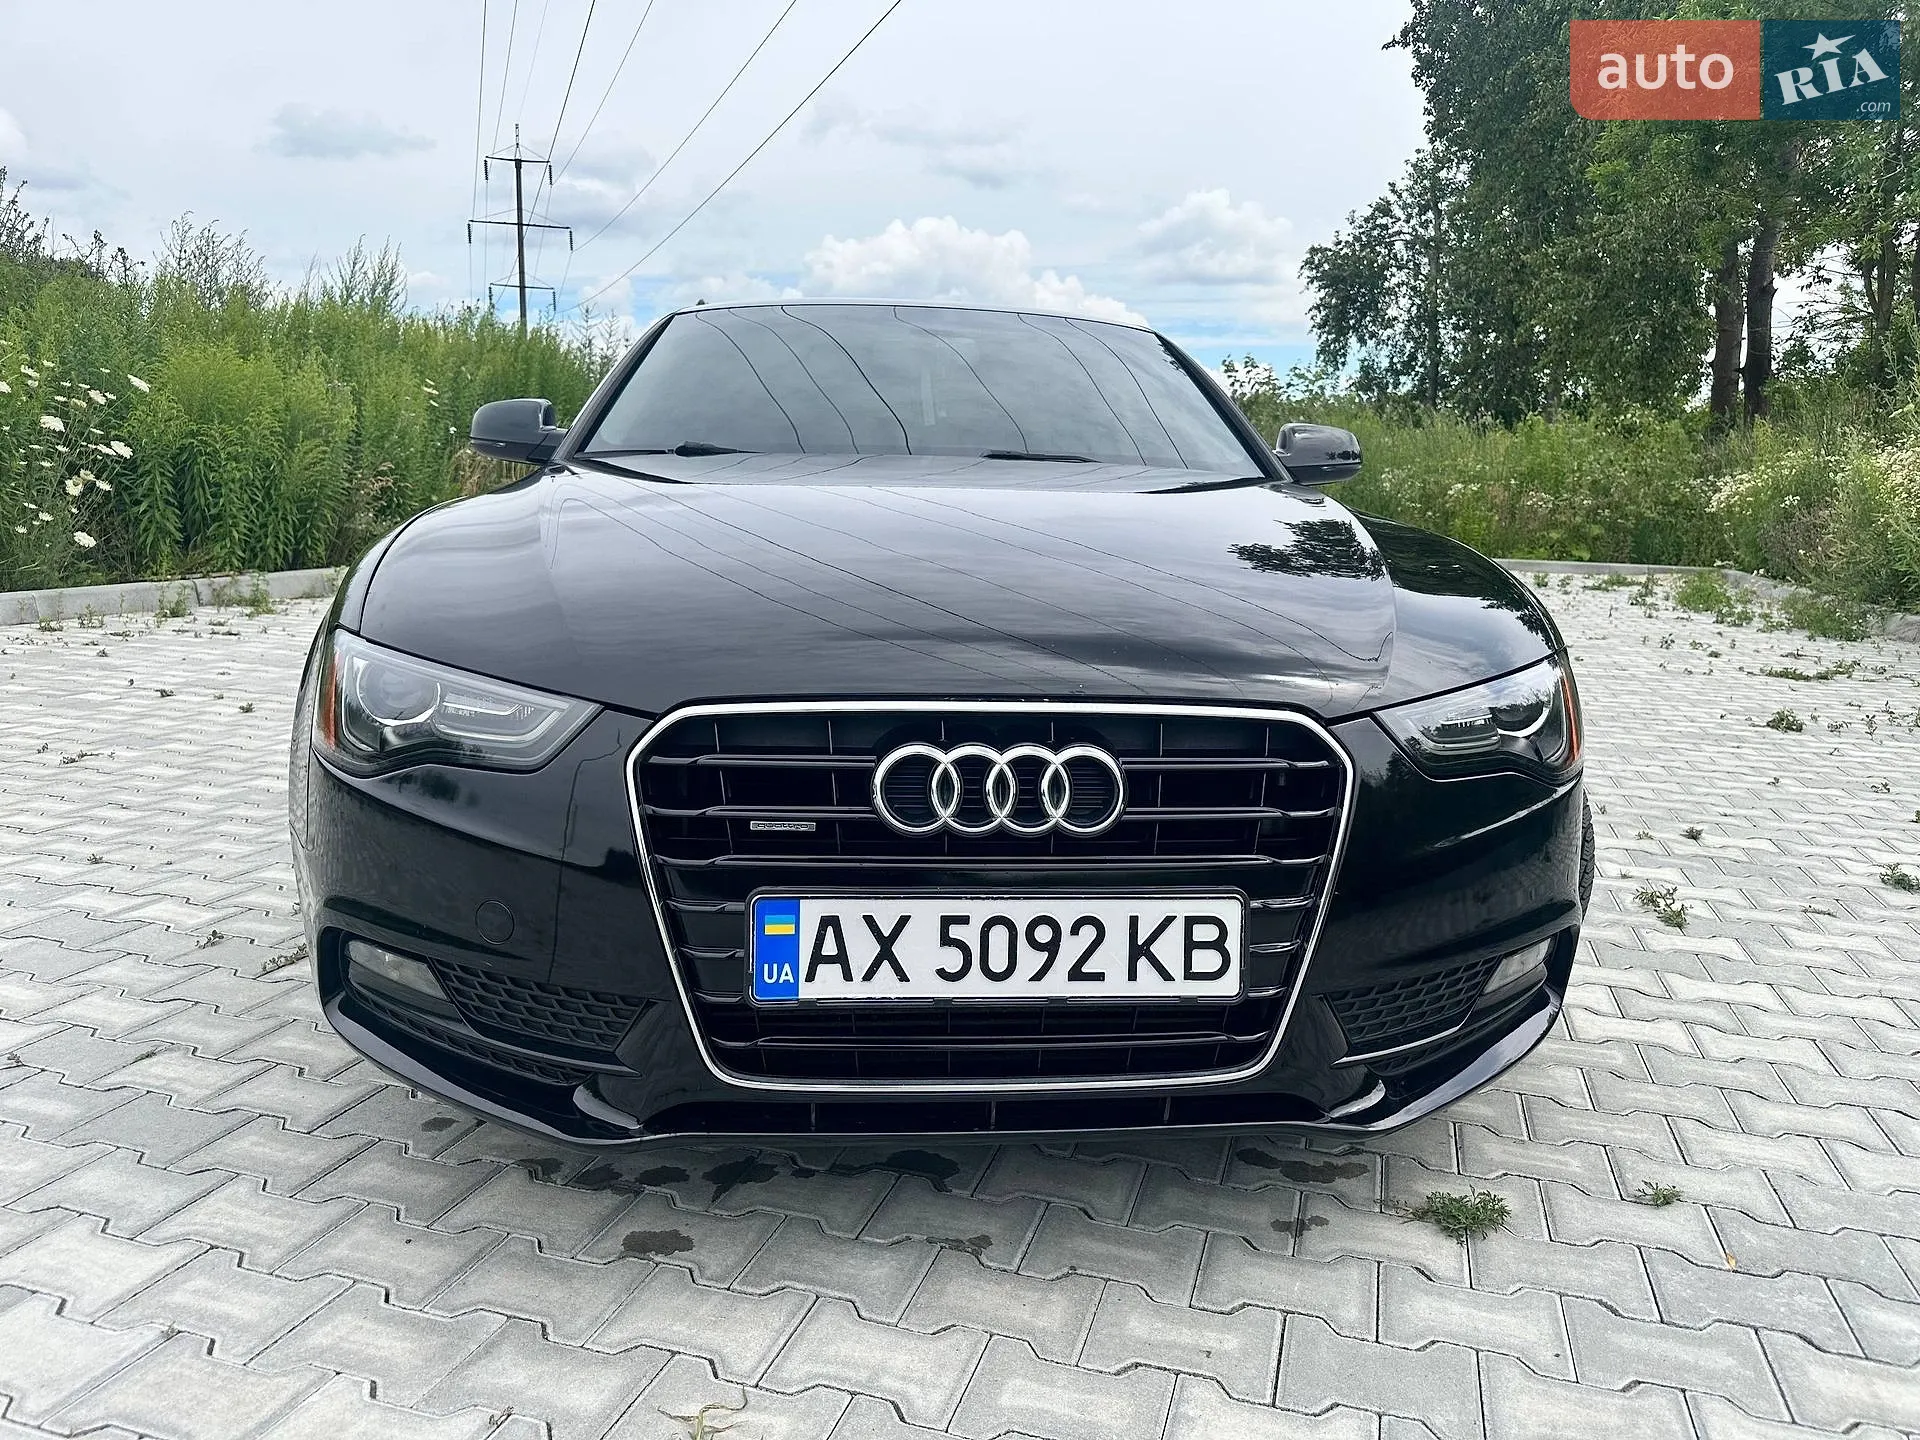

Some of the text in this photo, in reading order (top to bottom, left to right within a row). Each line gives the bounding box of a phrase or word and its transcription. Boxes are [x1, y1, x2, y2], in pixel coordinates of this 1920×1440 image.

[804, 914, 1232, 983] AX 5092 KB
[763, 963, 795, 984] UA
